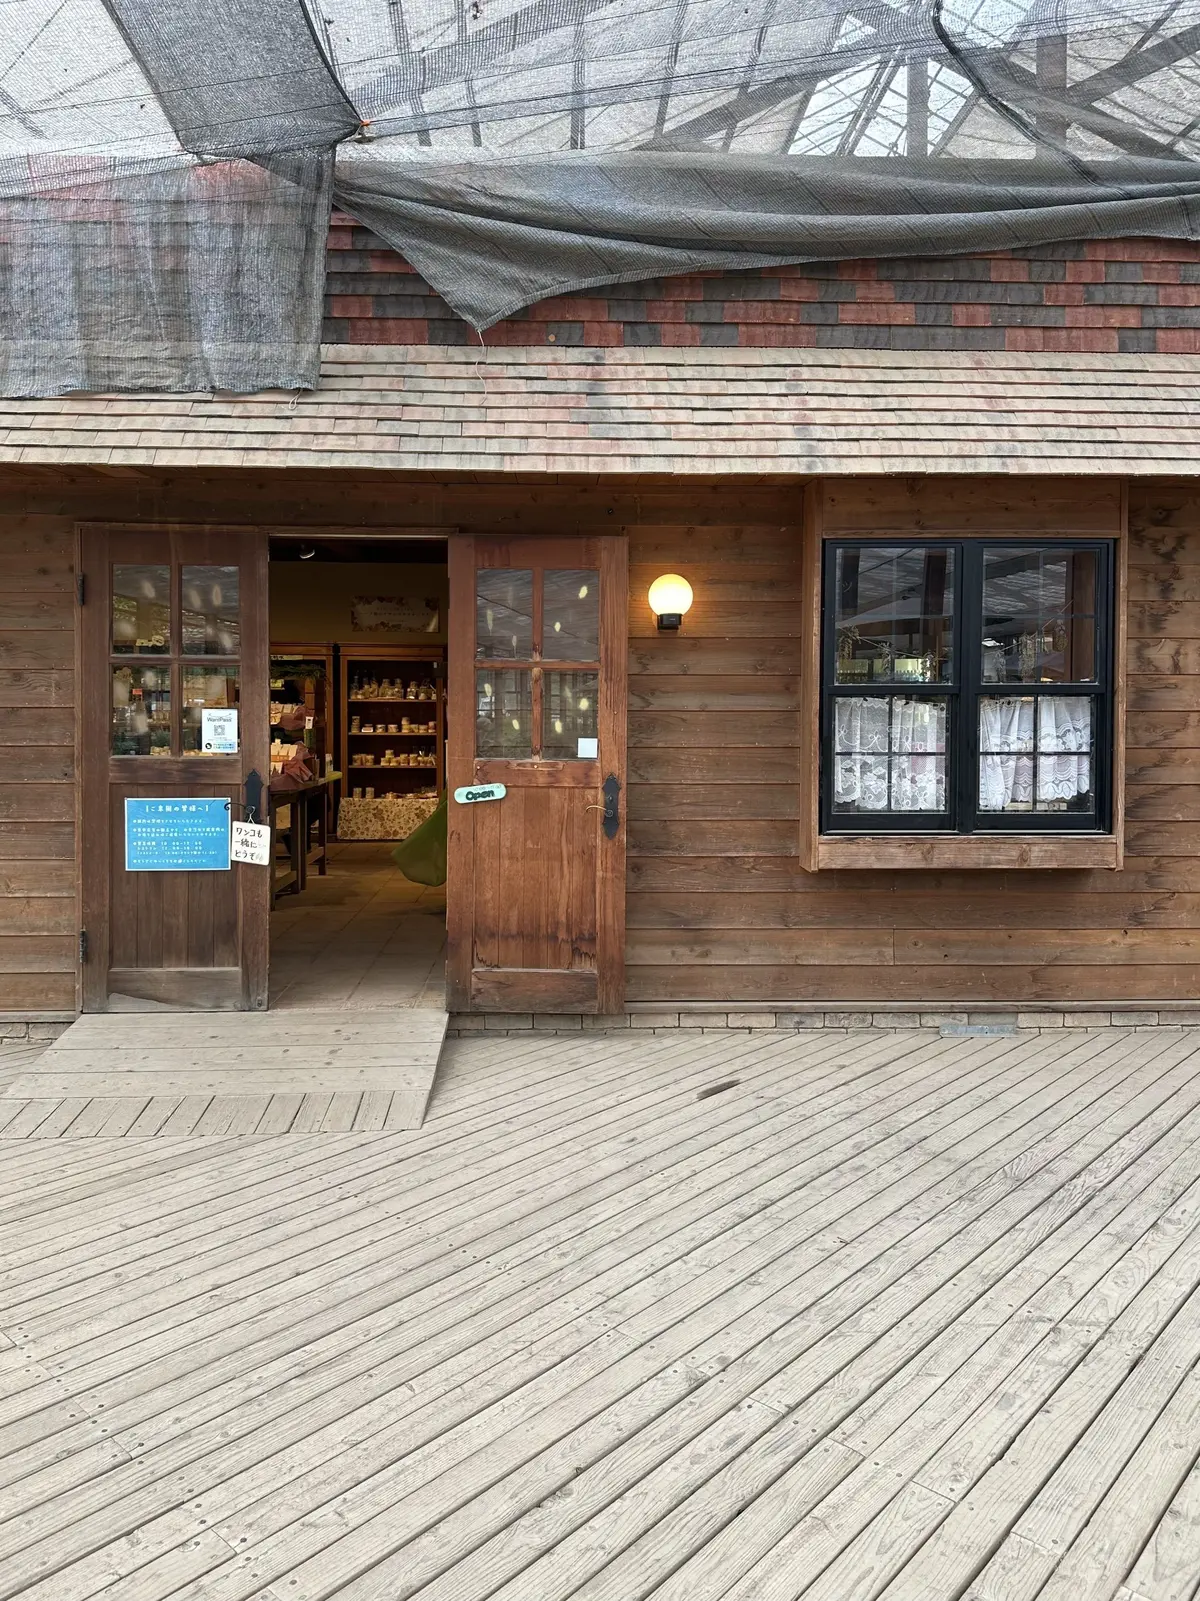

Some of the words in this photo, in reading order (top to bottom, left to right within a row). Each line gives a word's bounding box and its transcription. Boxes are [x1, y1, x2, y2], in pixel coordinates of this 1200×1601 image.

[465, 789, 495, 801] Open
[236, 827, 263, 838] ワンコも
[234, 838, 258, 848] 一緒に
[235, 849, 256, 861] どうぞ
